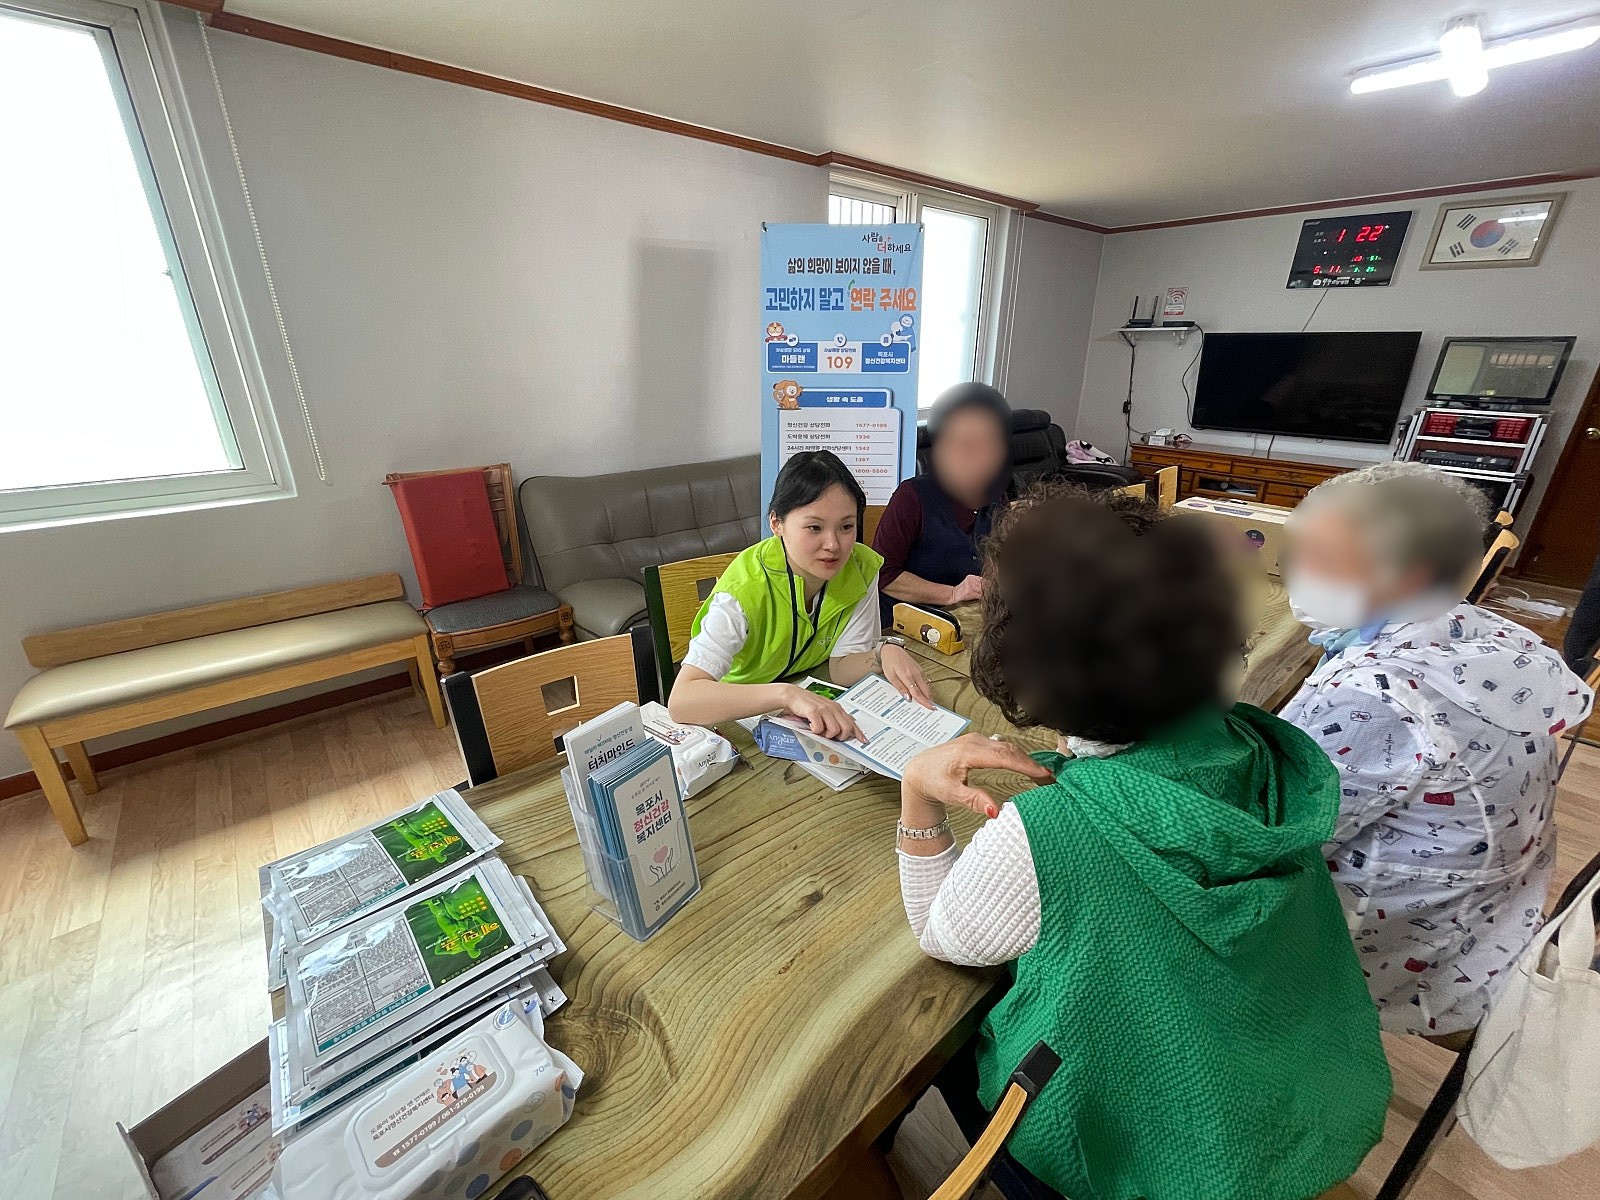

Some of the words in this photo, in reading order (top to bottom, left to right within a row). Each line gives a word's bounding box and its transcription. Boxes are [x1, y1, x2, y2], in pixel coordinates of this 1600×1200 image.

[1355, 225, 1384, 243] 22
[787, 258, 805, 275] 삶의
[807, 258, 833, 274] 희망이
[835, 258, 861, 275] 보이지
[863, 258, 881, 275] 않을
[882, 258, 896, 276] 때,
[765, 287, 815, 312] 고민하지
[819, 287, 845, 312] 말고
[850, 287, 877, 312] 연락
[879, 287, 917, 312] 주세요
[826, 355, 853, 369] 109
[588, 738, 635, 770] 터치마인드
[633, 799, 669, 832] 정신건강
[636, 790, 663, 816] 목포시
[637, 811, 672, 844] 복지센터
[401, 1120, 437, 1149] 1577-0199
